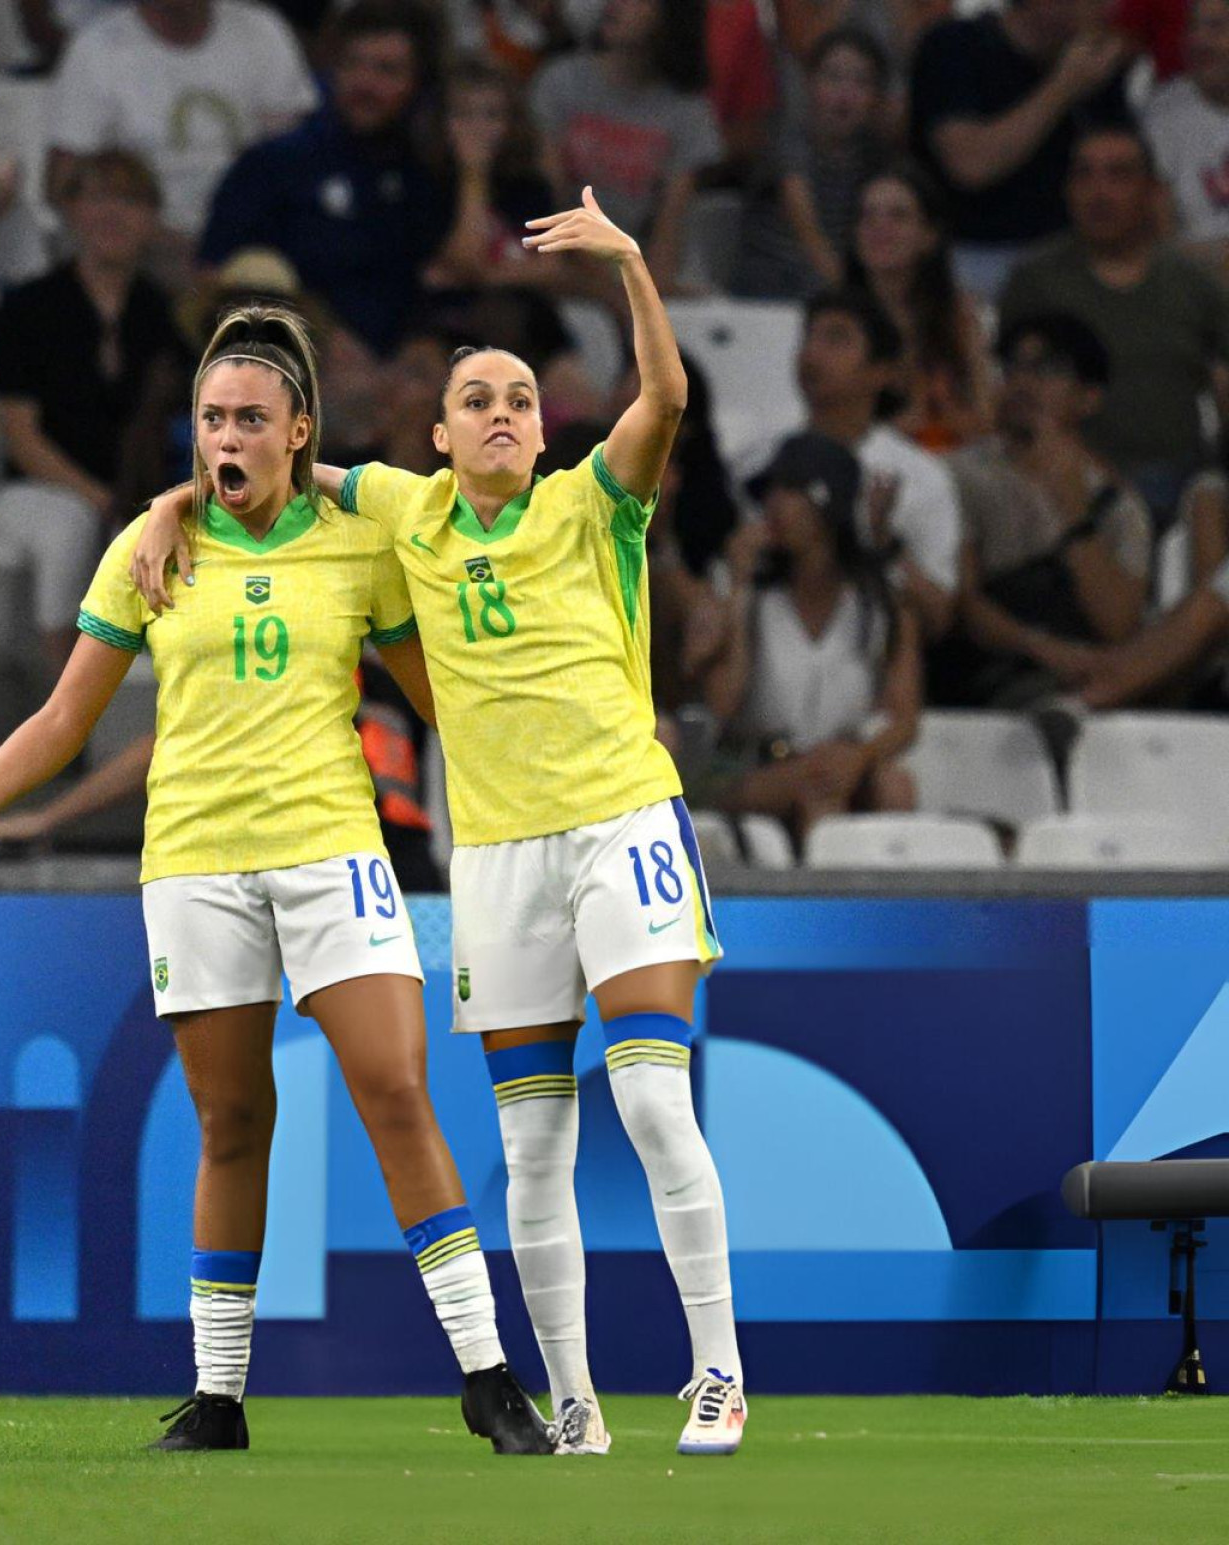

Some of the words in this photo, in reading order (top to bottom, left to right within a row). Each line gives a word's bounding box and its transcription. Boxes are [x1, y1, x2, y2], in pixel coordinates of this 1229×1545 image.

[457, 580, 516, 643] 18
[233, 615, 289, 681] 19
[346, 858, 396, 919] 19
[628, 840, 683, 906] 18
